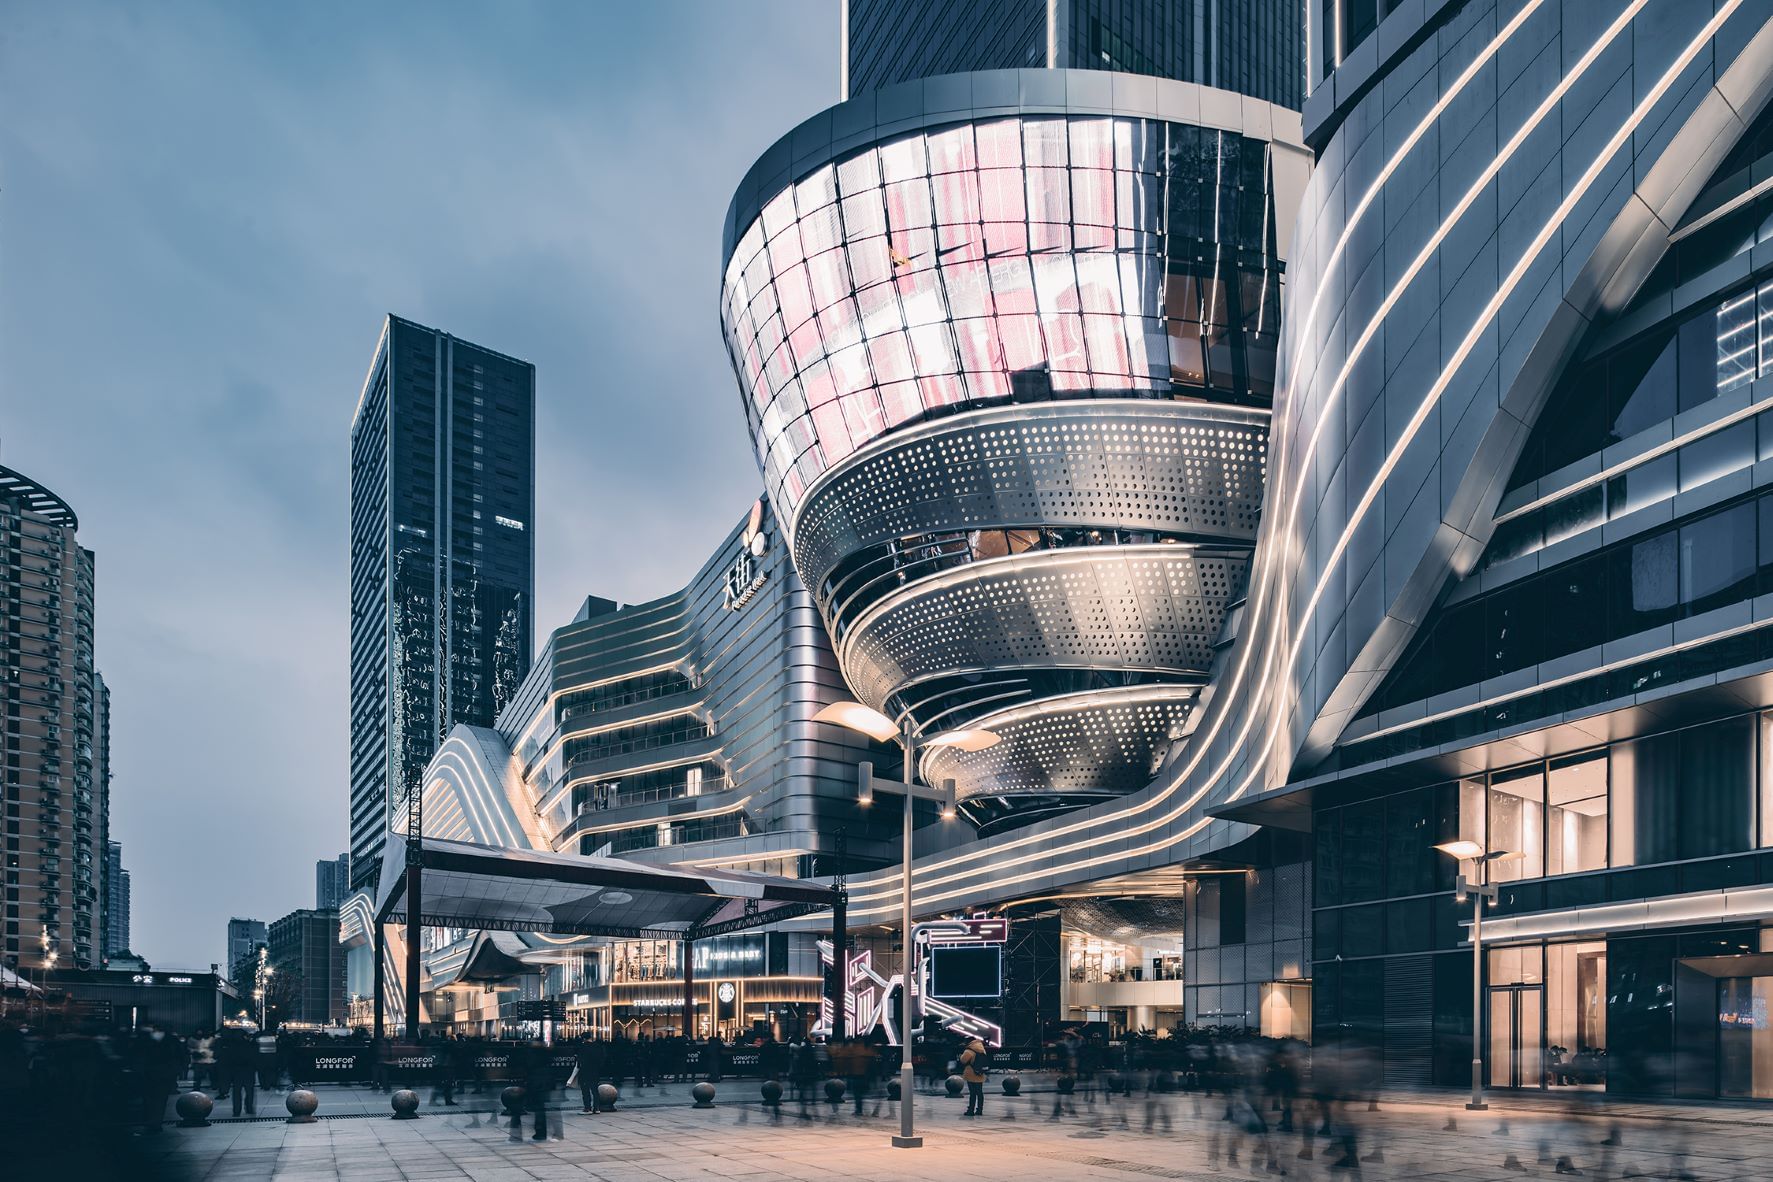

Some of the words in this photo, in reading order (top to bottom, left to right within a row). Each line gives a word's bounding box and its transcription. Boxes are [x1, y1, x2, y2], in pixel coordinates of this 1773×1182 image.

[722, 548, 751, 610] 天街
[692, 946, 709, 969] AP
[633, 998, 672, 1007] STARBUCKS
